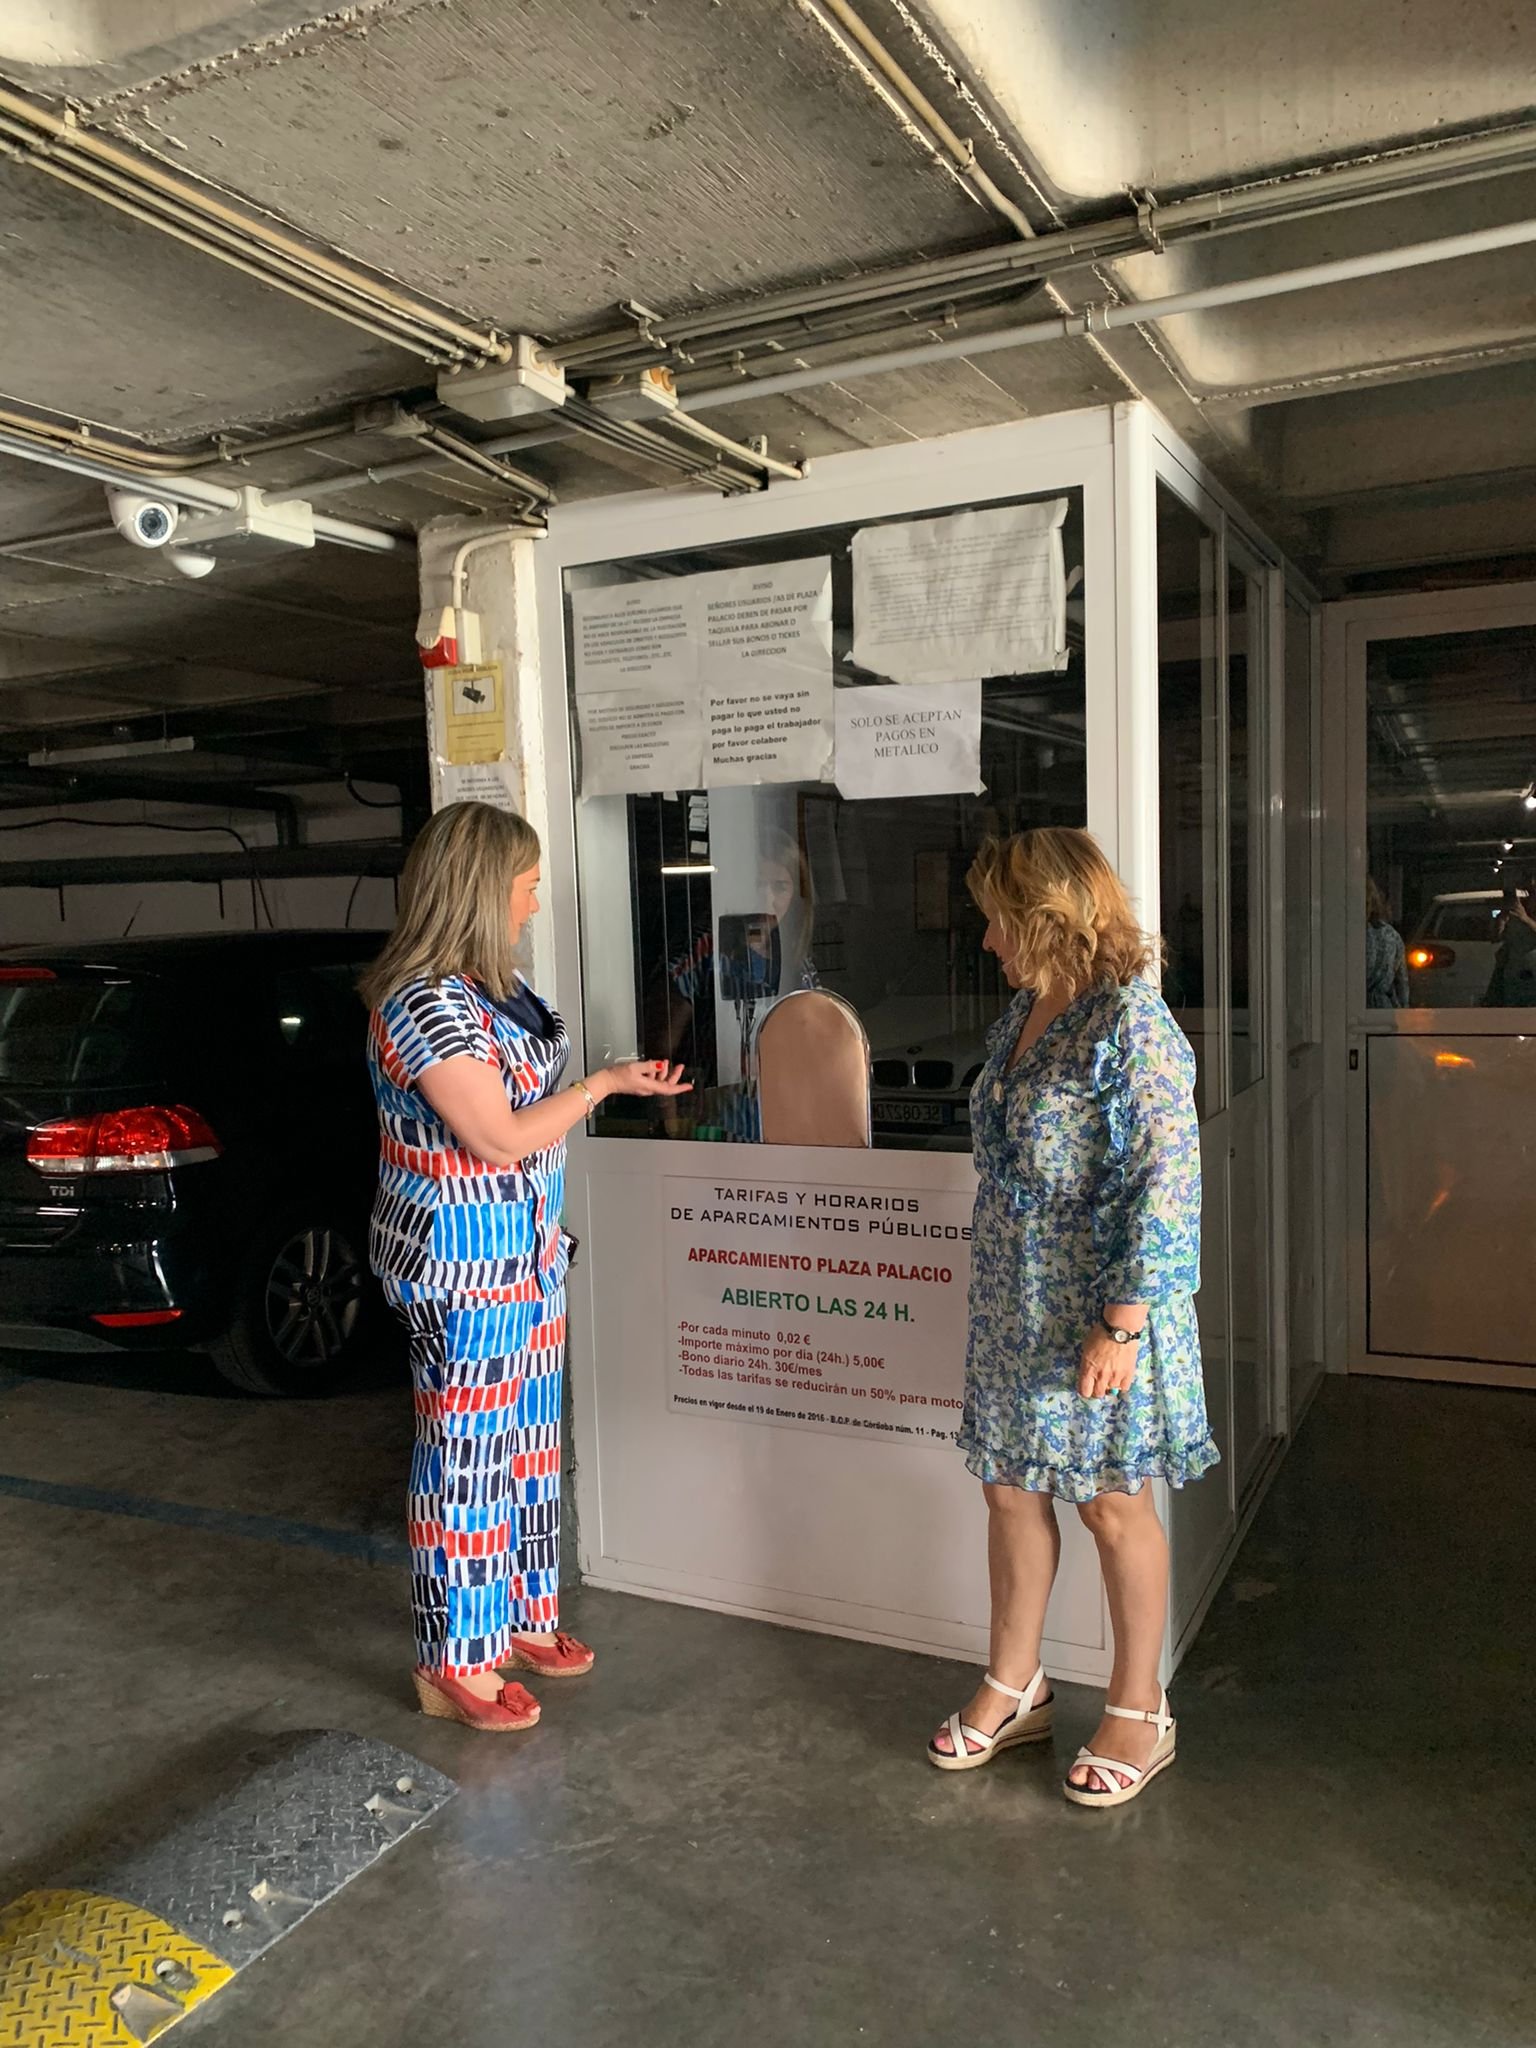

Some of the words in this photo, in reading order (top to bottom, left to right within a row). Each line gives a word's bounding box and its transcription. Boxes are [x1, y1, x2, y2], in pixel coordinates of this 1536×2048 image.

[708, 600, 736, 610] SEÑORES
[738, 597, 772, 607] USUARIOS
[786, 592, 795, 600] DE
[797, 590, 818, 599] PLAZA
[708, 613, 736, 622] PALACIO
[737, 611, 758, 620] DEBEN
[760, 608, 769, 616] DE
[771, 606, 792, 615] PASAR
[794, 604, 808, 612] POR
[708, 626, 739, 635] TAQUILLA
[741, 623, 758, 631] PARA
[760, 620, 790, 628] ABONAR
[708, 638, 731, 648] SELLAR
[732, 637, 745, 645] SUS
[746, 634, 770, 642] BONOS
[778, 630, 800, 639] TICKES
[751, 647, 787, 656] DIRECCION
[710, 698, 724, 706] Por
[762, 694, 772, 702] se
[774, 692, 794, 700] vaya
[797, 690, 810, 698] sin
[711, 714, 734, 722] pagar
[747, 710, 762, 718] que
[764, 706, 788, 716] usted
[850, 716, 882, 728] SOLO
[885, 714, 900, 726] SE
[902, 710, 962, 724] ACEPTAN
[712, 726, 732, 736] paga
[744, 724, 764, 733] paga
[766, 722, 775, 730] el
[777, 718, 820, 728] trabajador
[876, 729, 916, 742] PAGOS
[919, 728, 936, 739] EN
[712, 741, 725, 750] por
[751, 736, 788, 745] colabore
[874, 743, 939, 758] METALICO
[713, 754, 744, 764] Muchas
[746, 752, 777, 763] gracias
[714, 1188, 788, 1204] TARIFAS
[796, 1192, 807, 1205] Y
[814, 1193, 920, 1212] HORARIOS
[671, 1208, 694, 1220] DE
[700, 1210, 860, 1232] APARCAMIENTOS
[868, 1217, 972, 1240] PÚBLICOS
[688, 1248, 812, 1272] APARCAMIENTO
[817, 1258, 872, 1277] PLAZA
[877, 1262, 952, 1283] PALACIO
[721, 1288, 810, 1312] ABIERTO
[816, 1296, 857, 1317] LAS
[864, 1301, 888, 1320] 24
[894, 1304, 916, 1322] H.
[678, 1321, 699, 1332] -Por
[702, 1325, 728, 1336] cada
[732, 1328, 770, 1341] minuto
[776, 1332, 800, 1344] 0,02
[803, 1334, 812, 1346] €
[678, 1336, 722, 1350] -Importe
[726, 1342, 770, 1356] máximo
[773, 1348, 793, 1359] por
[816, 1351, 850, 1367] (24h.)
[853, 1355, 886, 1369] 5,00€
[678, 1350, 710, 1363] -Bono
[714, 1354, 745, 1368] diario
[748, 1358, 772, 1370] 24h.
[776, 1361, 822, 1376] 30€/mes
[679, 1364, 714, 1378] -Todas
[718, 1369, 734, 1380] las
[737, 1372, 772, 1386] tarifas
[775, 1378, 788, 1388] se
[792, 1380, 847, 1395] reducirán
[851, 1388, 867, 1398] un
[870, 1388, 896, 1402] 50%
[900, 1394, 927, 1405] para
[931, 1398, 964, 1410] moto
[674, 1394, 698, 1405] Precios
[708, 1400, 726, 1410] vigor
[726, 1402, 746, 1411] desde
[756, 1406, 764, 1414] 19
[776, 1408, 796, 1418] Enero
[852, 1418, 862, 1426] de
[864, 1420, 894, 1431] Córdoba
[896, 1424, 914, 1434] núm.
[916, 1427, 924, 1435] 11
